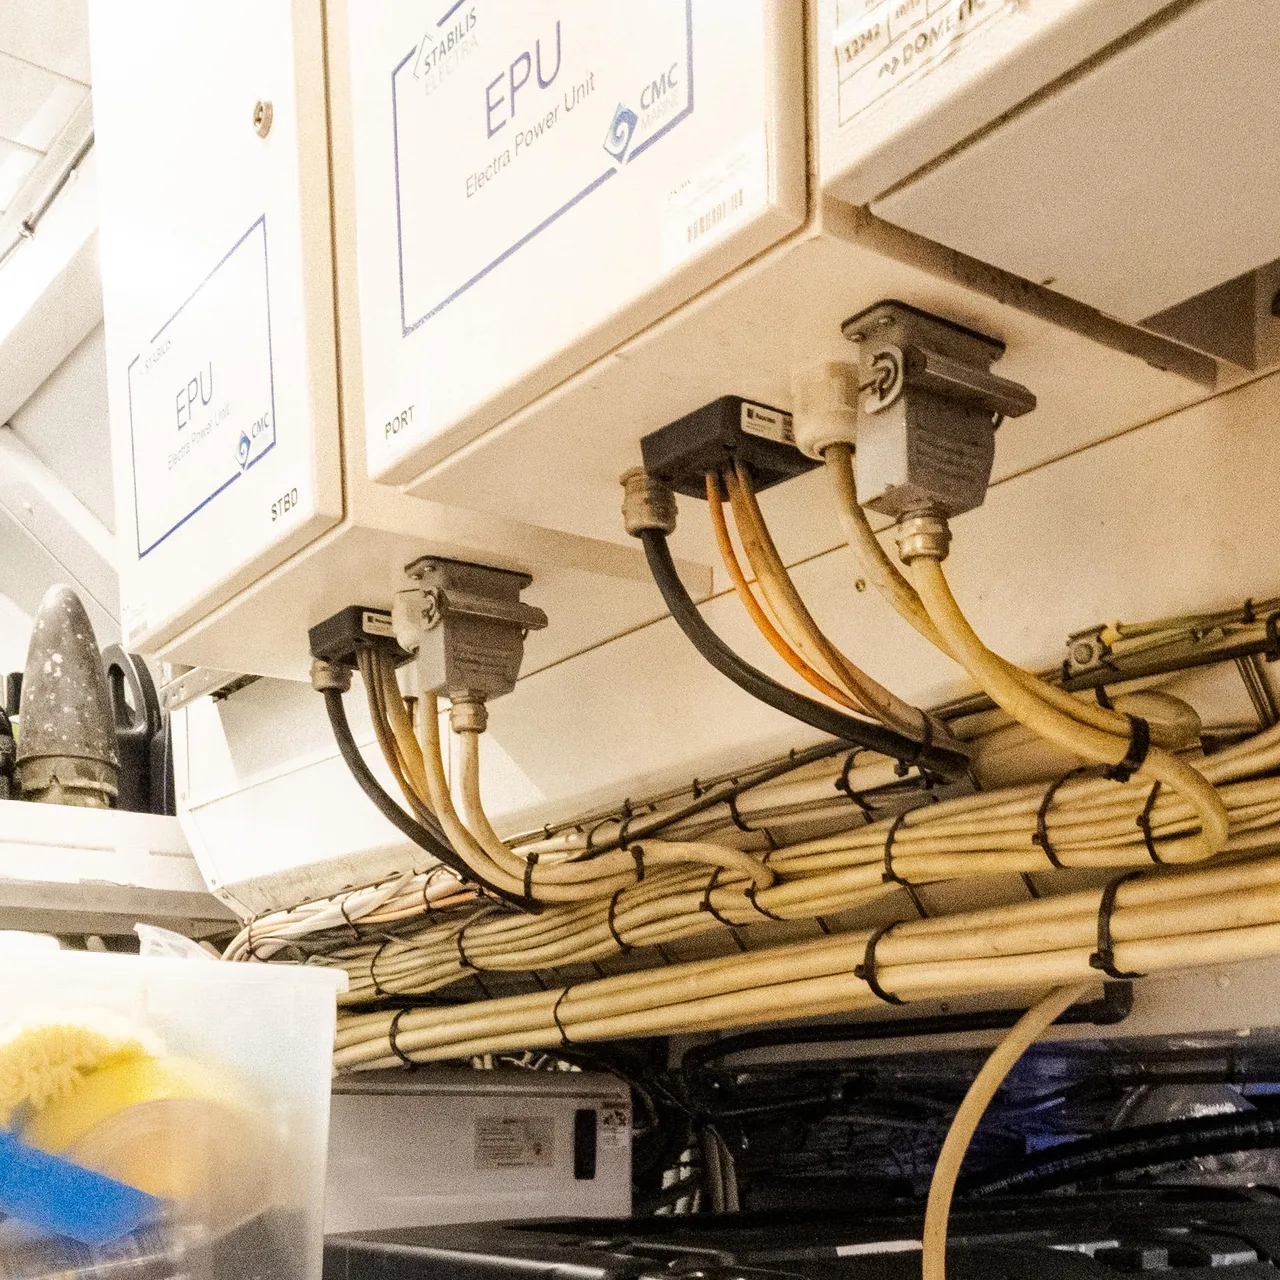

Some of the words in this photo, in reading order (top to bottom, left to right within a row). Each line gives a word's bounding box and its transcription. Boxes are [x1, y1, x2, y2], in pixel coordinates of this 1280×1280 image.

[424, 7, 477, 77] STABILIS
[424, 33, 480, 96] ELECTRA
[485, 20, 561, 140] EPU
[639, 62, 679, 111] CMC
[465, 148, 512, 199] Electra
[515, 104, 560, 157] Power
[564, 71, 596, 112] Unit
[175, 361, 214, 431] EPU
[251, 412, 270, 439] CMC
[385, 404, 415, 440] PORT
[271, 487, 298, 522] STBD
